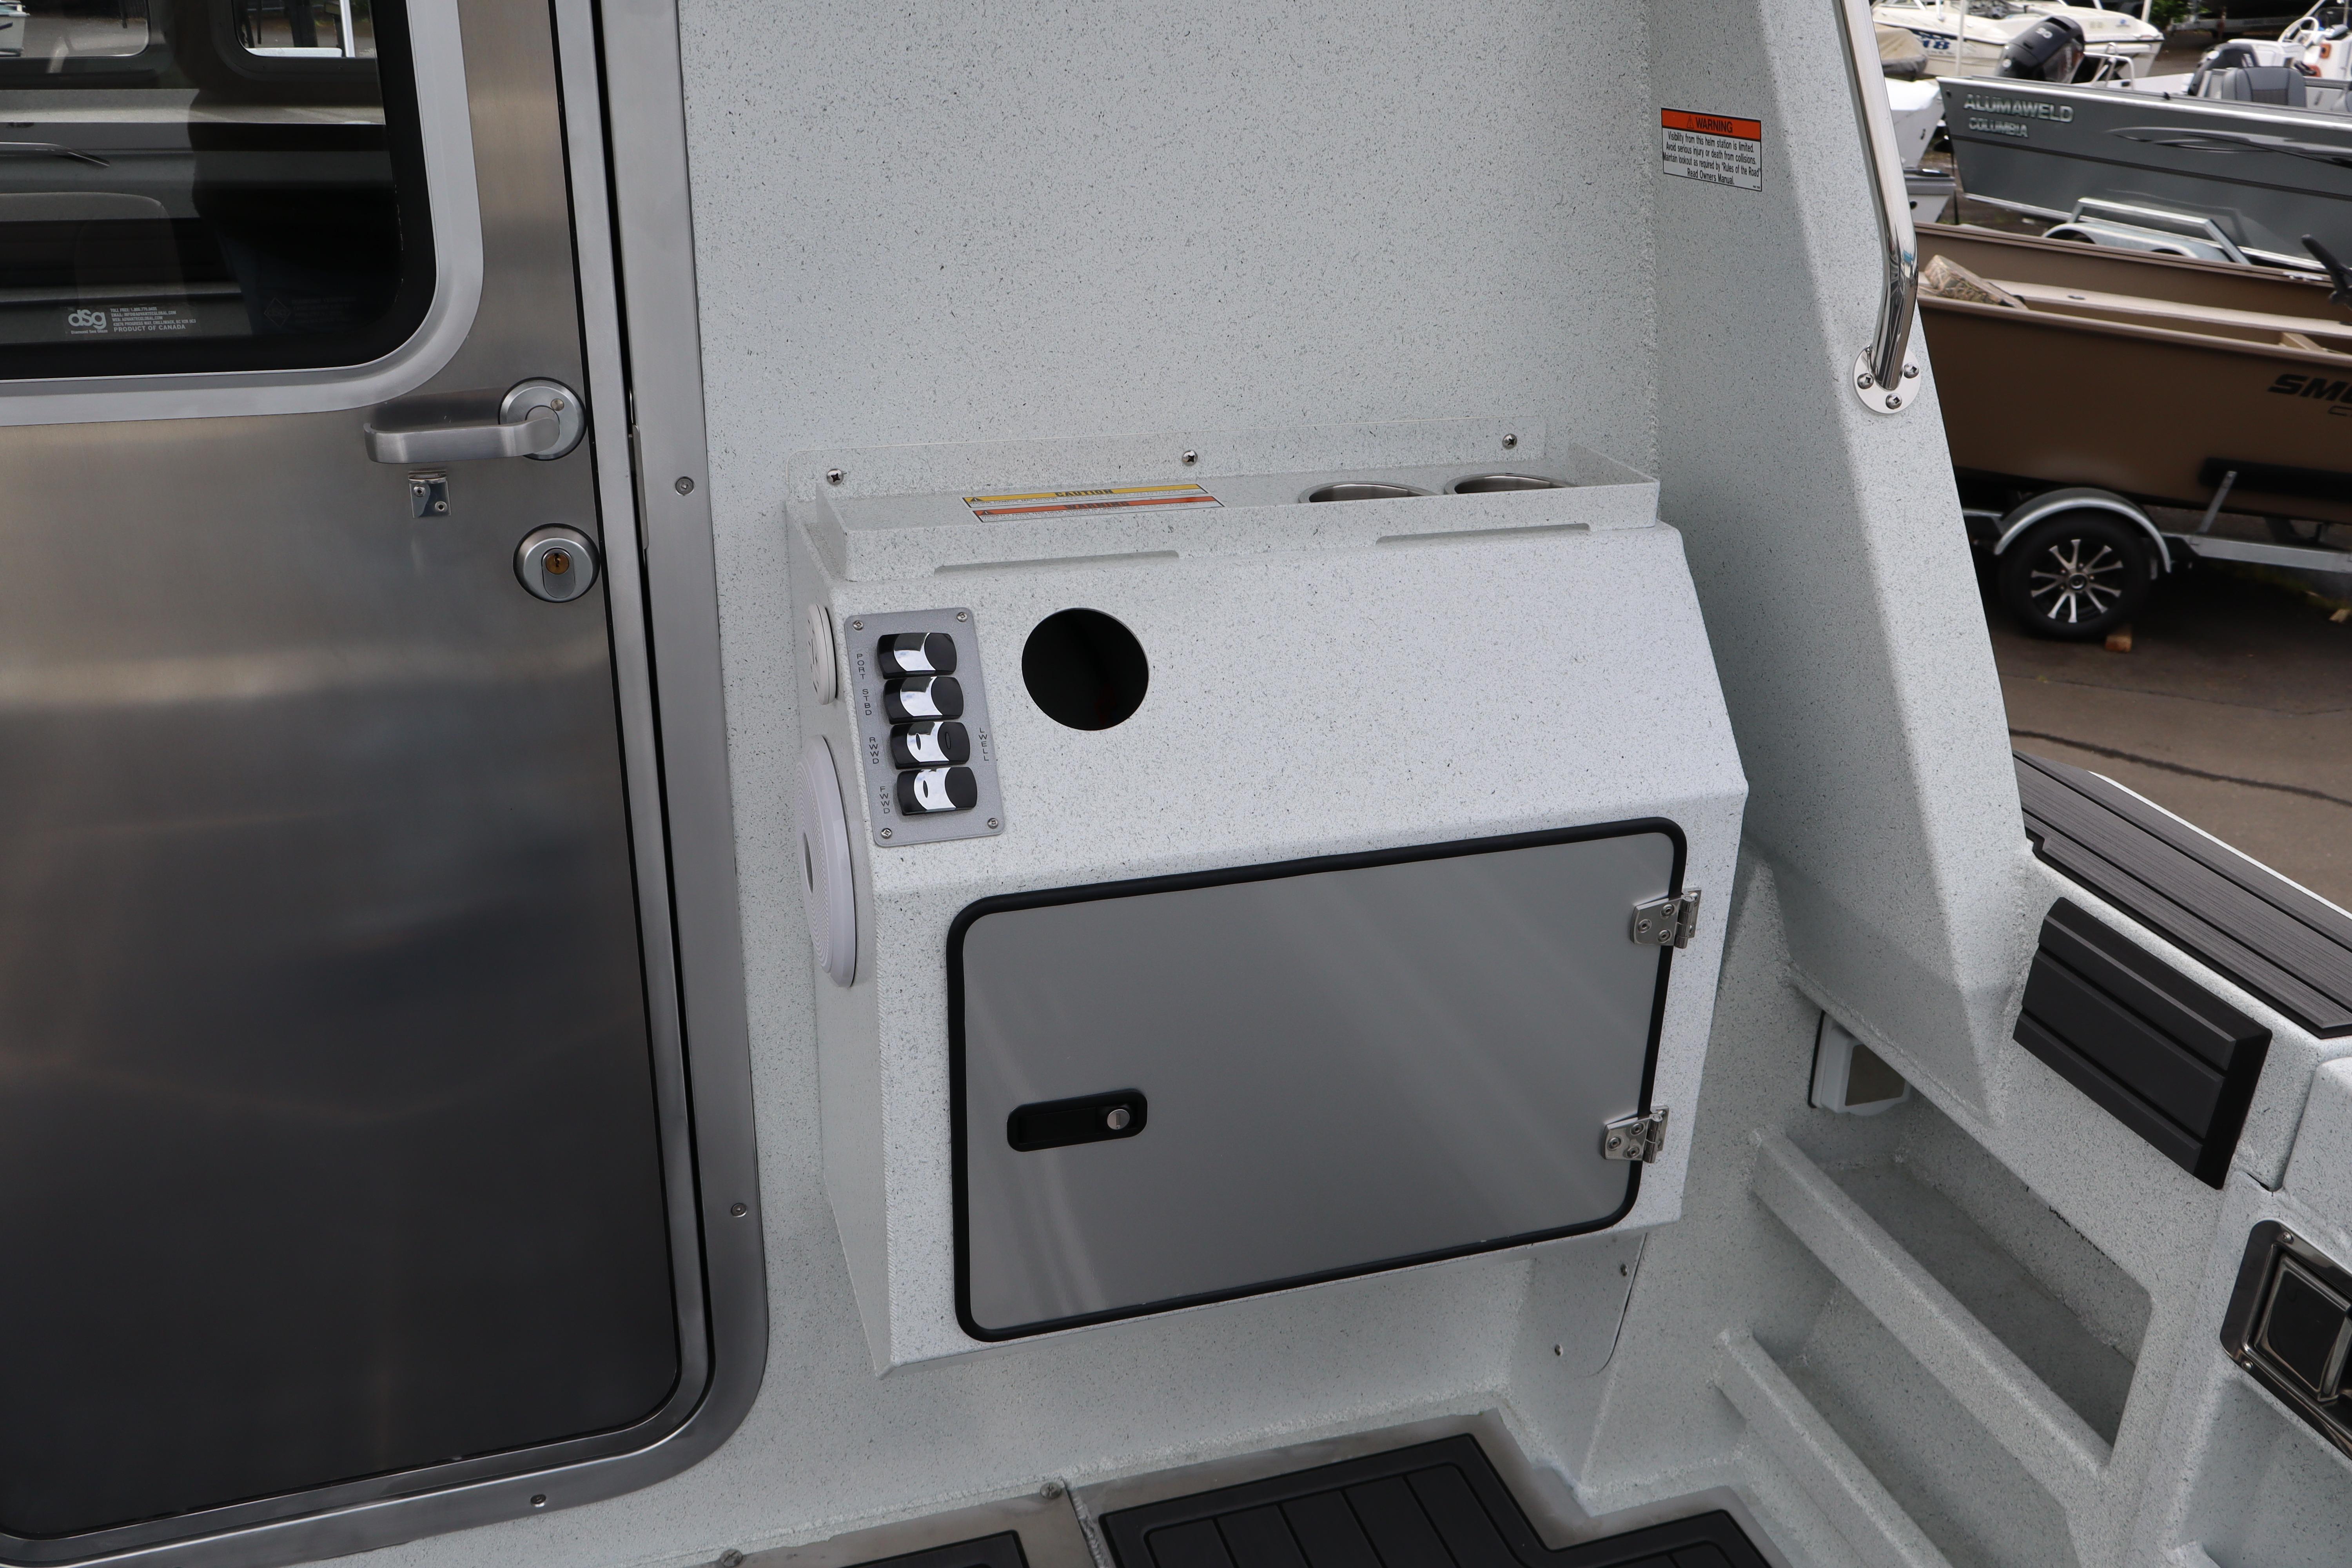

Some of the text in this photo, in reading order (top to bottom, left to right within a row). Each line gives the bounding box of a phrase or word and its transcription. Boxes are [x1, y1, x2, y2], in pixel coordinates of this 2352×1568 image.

[1963, 94, 2074, 123] ALUMAWELD
[1696, 117, 1733, 133] WARNING
[1969, 117, 2028, 138] COLUMBIA
[1668, 131, 1684, 144] Visibility
[1686, 134, 1695, 143] from
[1706, 137, 1715, 147] helm
[1717, 139, 1731, 149] station
[1733, 140, 1737, 151] is
[1739, 142, 1754, 153] limited.
[1662, 152, 1678, 163] Maintain
[1679, 154, 1692, 166] lookout
[1699, 159, 1714, 170] required
[1716, 161, 1720, 172] by
[1735, 164, 1739, 174] of
[1666, 142, 1676, 151] Avoid
[1678, 144, 1691, 154] serious
[1693, 146, 1704, 158] injury
[1711, 149, 1723, 159] death
[1724, 151, 1734, 161] from
[1736, 153, 1757, 165] collisions.
[1687, 168, 1734, 185] Read Owners Manual.
[68, 309, 107, 329] dsg
[1064, 501, 1129, 510] WARNING
[857, 653, 866, 679] PORT
[862, 689, 872, 715] STBD
[869, 737, 880, 764] RWWD
[978, 727, 989, 761] LWELL
[879, 786, 890, 814] FWWD
